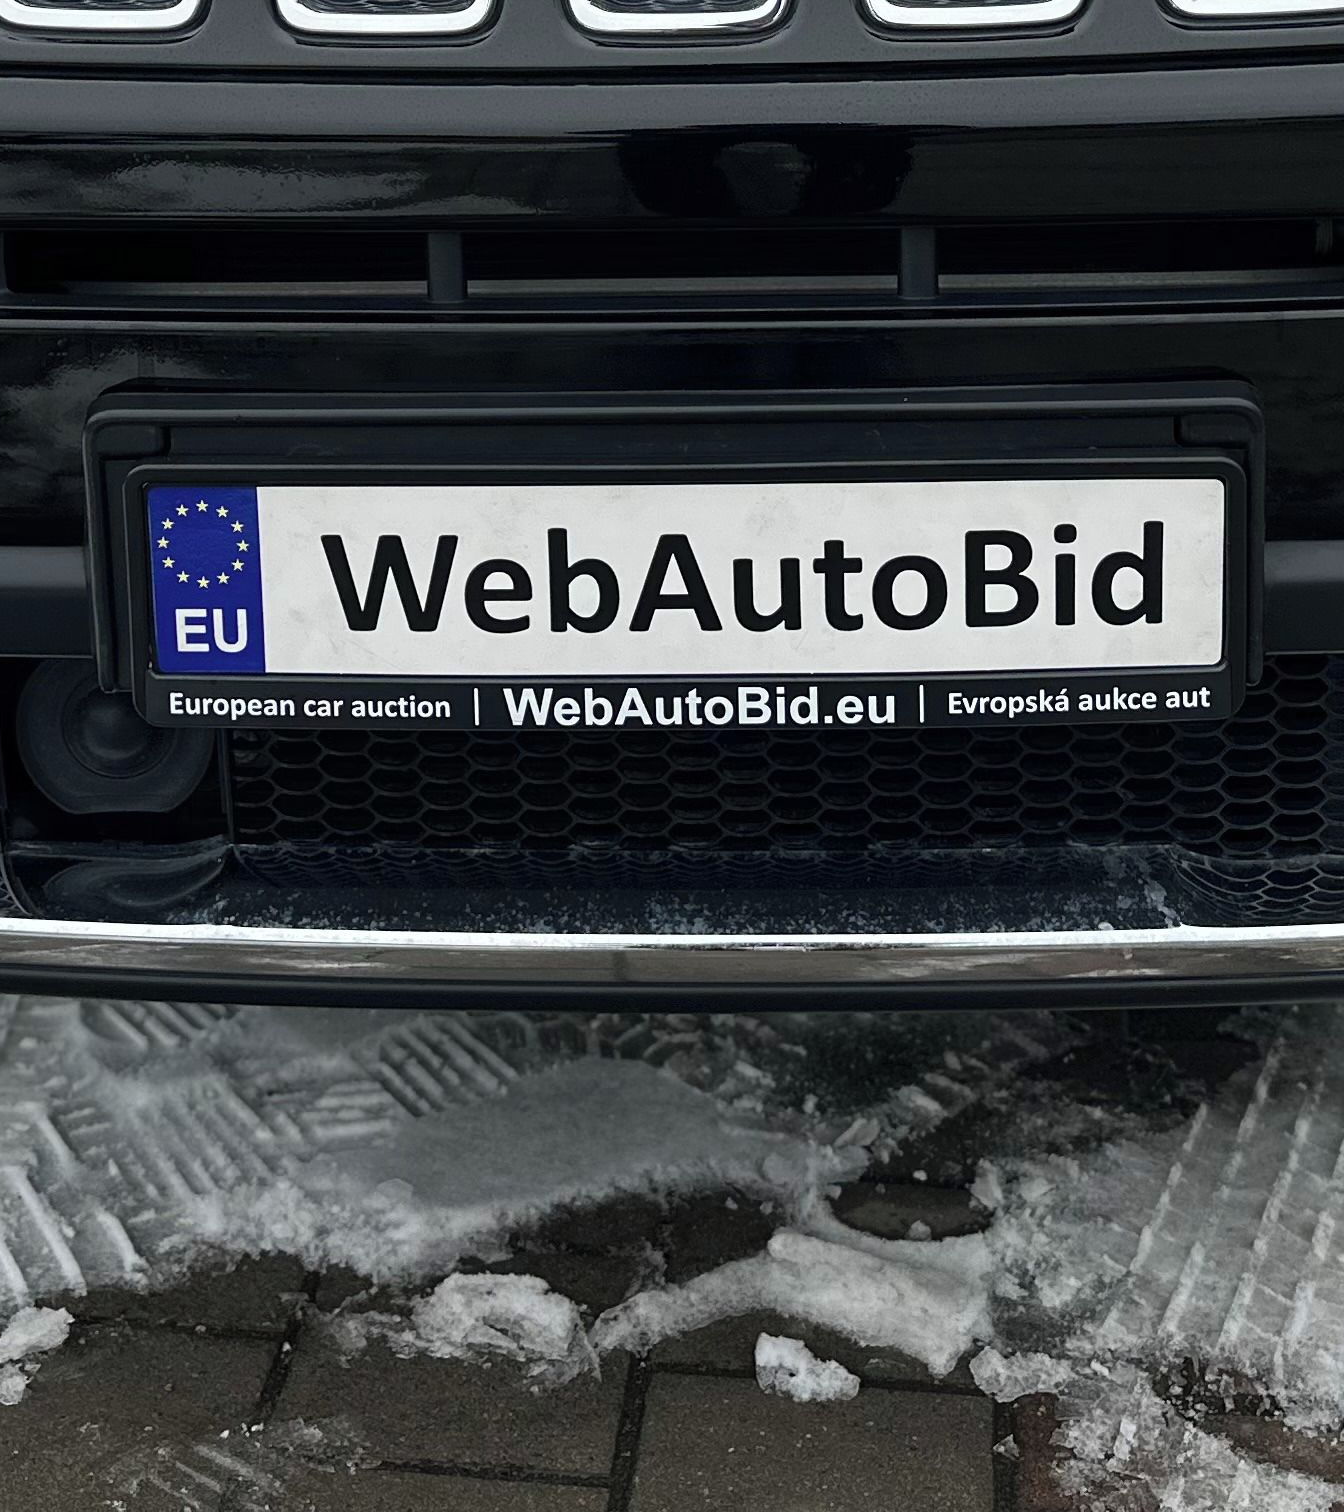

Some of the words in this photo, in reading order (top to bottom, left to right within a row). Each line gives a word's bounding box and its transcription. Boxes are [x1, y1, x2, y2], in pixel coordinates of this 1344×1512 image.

[320, 520, 1164, 634] WebAutoBid
[175, 608, 248, 653] EU
[169, 692, 296, 721] European
[303, 699, 344, 717] car
[351, 694, 451, 719] auction
[503, 687, 896, 727] WebAutoBid.eu
[948, 688, 1070, 719] Evropská
[1078, 686, 1157, 712] aukce
[1165, 686, 1211, 709] aut
